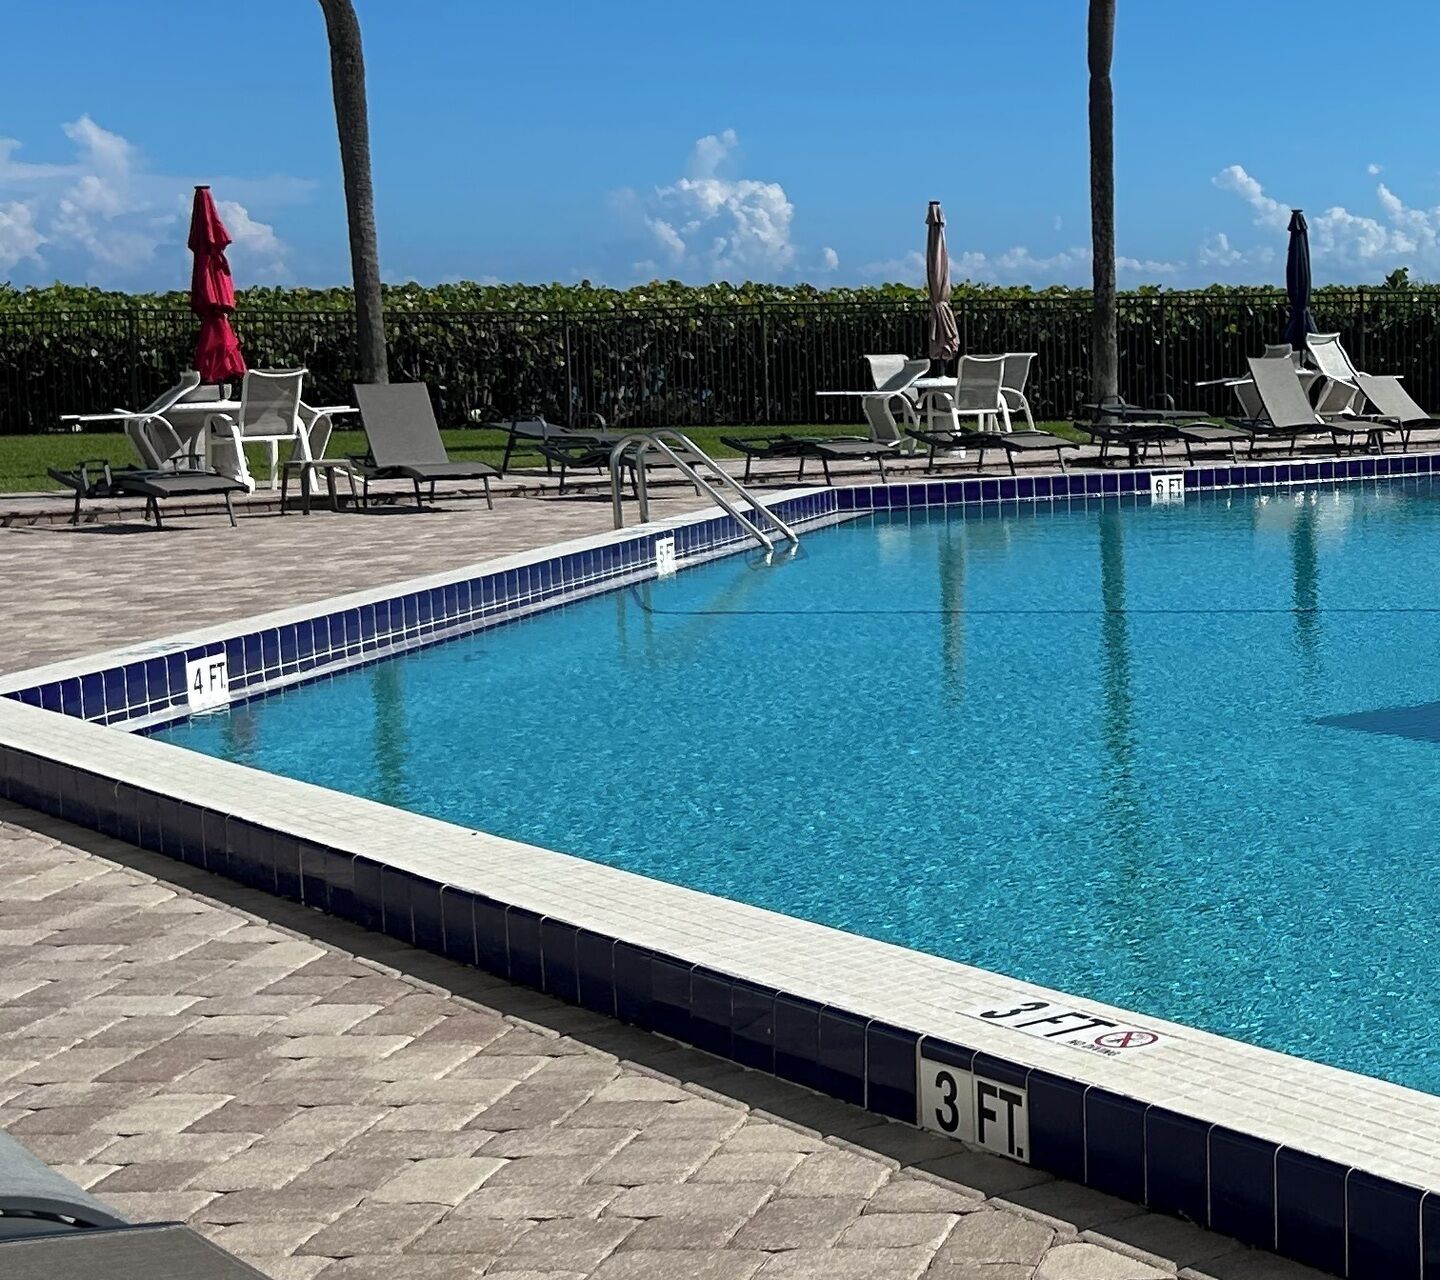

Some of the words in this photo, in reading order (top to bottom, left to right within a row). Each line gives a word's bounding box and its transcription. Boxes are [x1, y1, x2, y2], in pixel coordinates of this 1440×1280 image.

[1155, 479, 1164, 494] 6
[1169, 478, 1182, 494] FT
[193, 667, 204, 695] 4
[979, 1001, 1050, 1019] 3
[1014, 1011, 1117, 1038] FT
[935, 1070, 959, 1133] 3
[977, 1080, 1024, 1158] FT.
